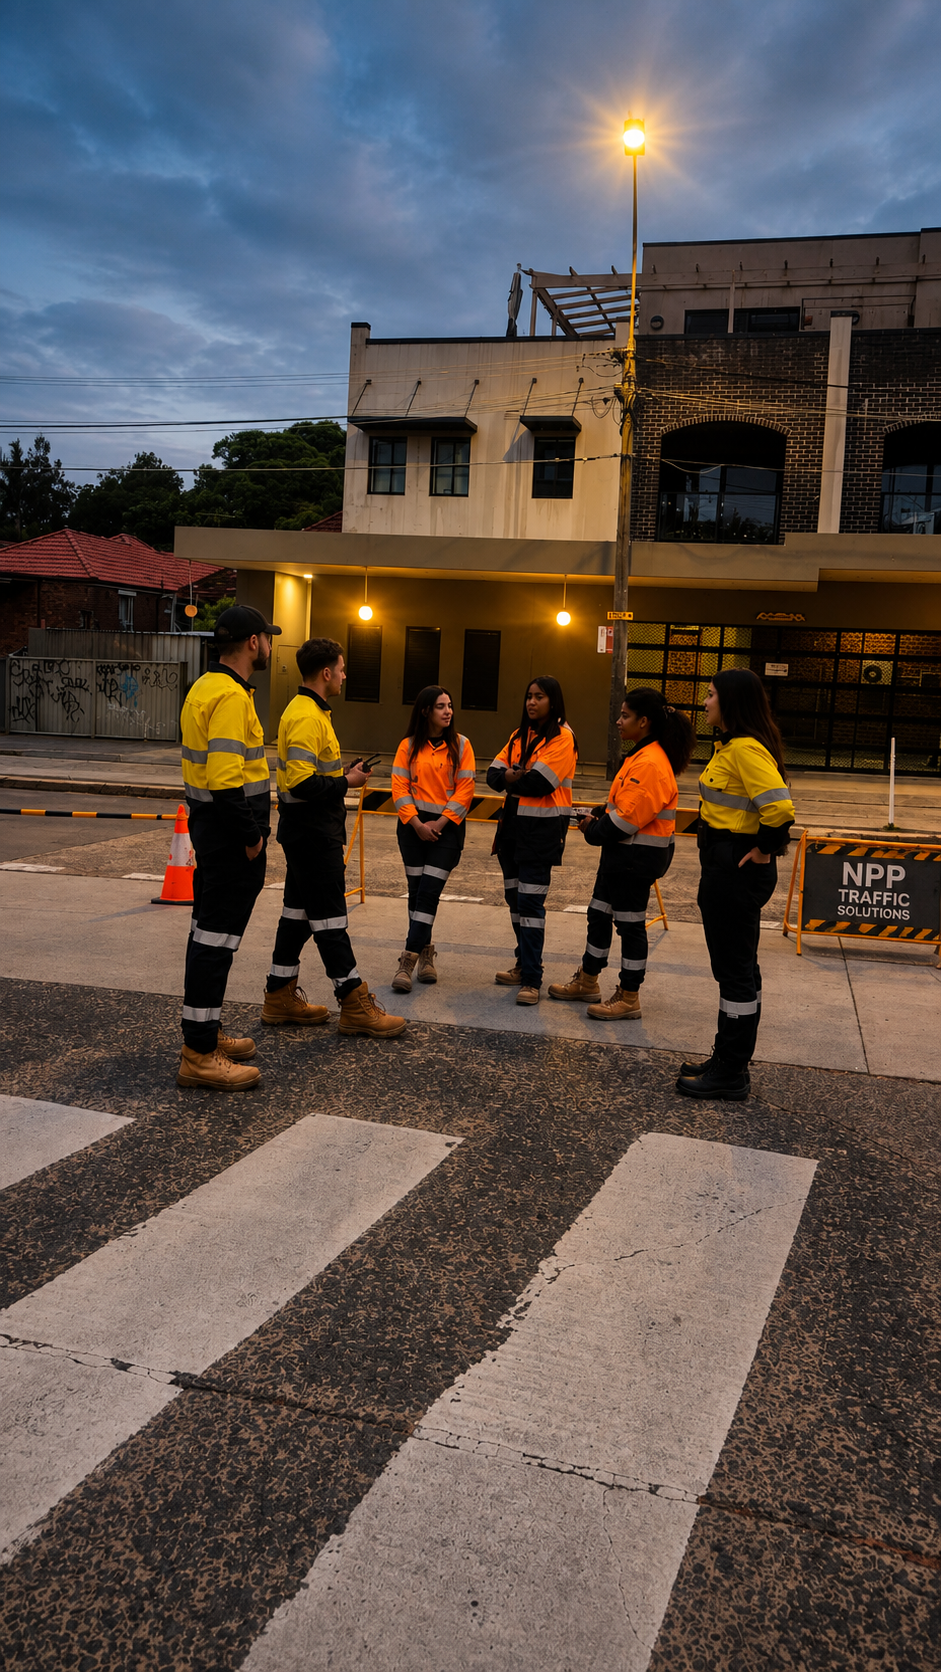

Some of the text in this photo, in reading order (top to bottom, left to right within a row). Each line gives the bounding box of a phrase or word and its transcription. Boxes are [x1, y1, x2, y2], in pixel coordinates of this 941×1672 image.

[842, 862, 906, 888] NPP
[838, 889, 910, 907] TRAFFIC
[837, 905, 910, 920] SOLUTIONS
